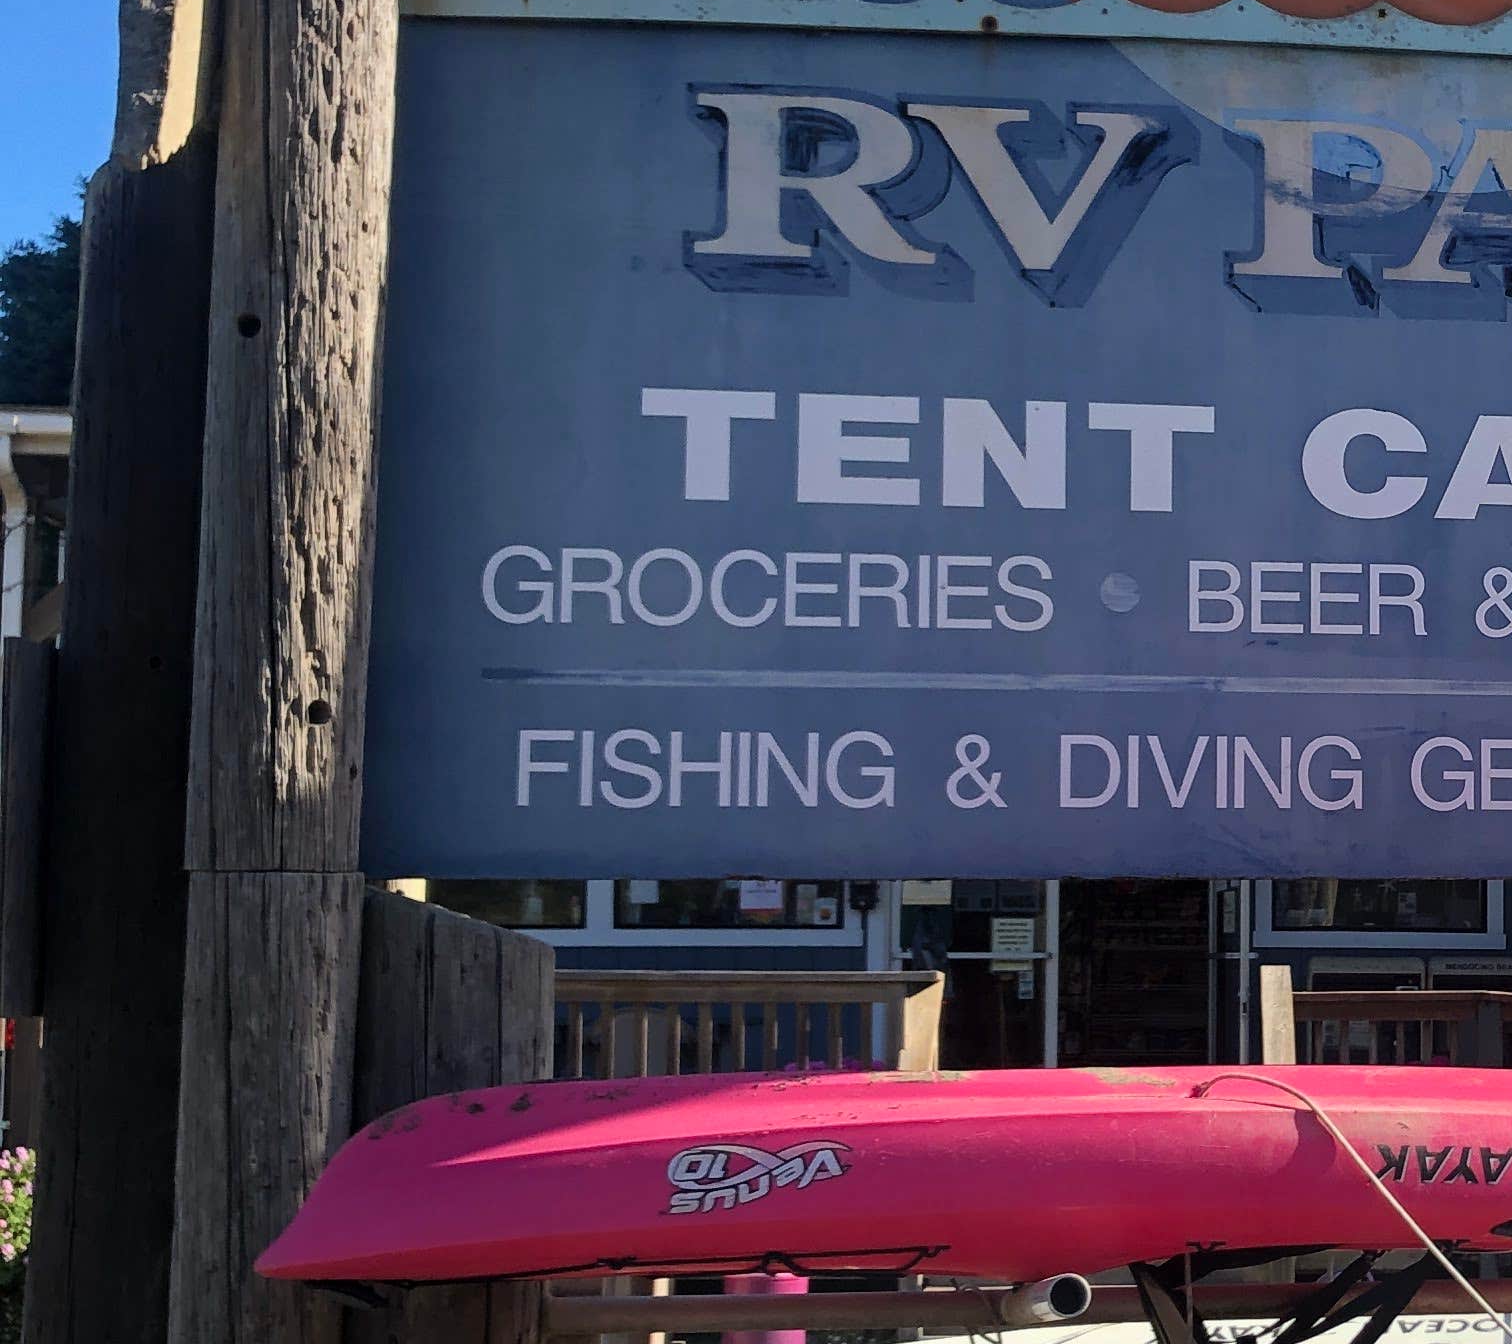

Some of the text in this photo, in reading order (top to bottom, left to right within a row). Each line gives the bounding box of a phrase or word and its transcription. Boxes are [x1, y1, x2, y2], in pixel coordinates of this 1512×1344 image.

[692, 90, 1172, 274] RV
[641, 387, 1215, 513] TENT
[481, 544, 1055, 633] GROCERIES
[1187, 559, 1428, 637] BEER
[516, 728, 896, 811] FISHING
[945, 733, 1009, 811] &
[1058, 733, 1365, 812] DIVING
[1385, 1318, 1502, 1334] OCEA
